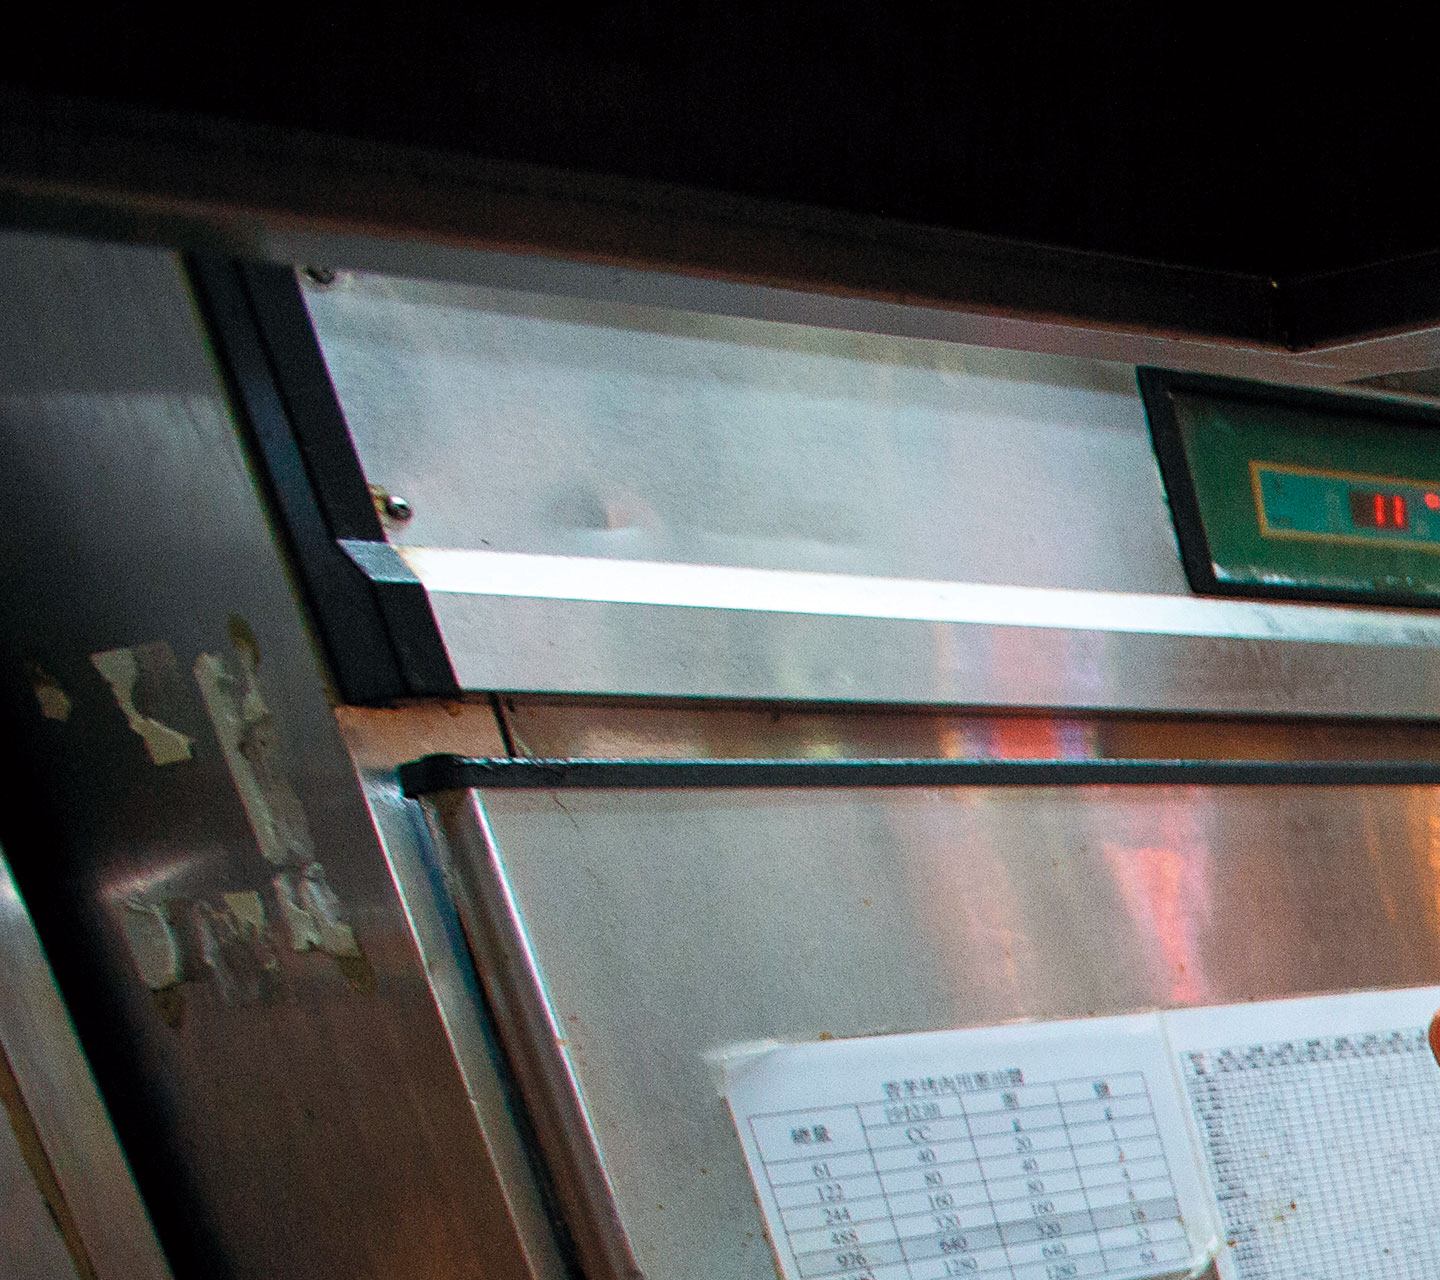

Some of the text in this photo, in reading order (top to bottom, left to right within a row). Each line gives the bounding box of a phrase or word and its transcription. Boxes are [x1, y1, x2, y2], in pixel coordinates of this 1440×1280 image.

[811, 1163, 831, 1177] 61
[815, 1185, 844, 1200] 122
[822, 1207, 851, 1222] 244
[927, 1193, 954, 1206] 160
